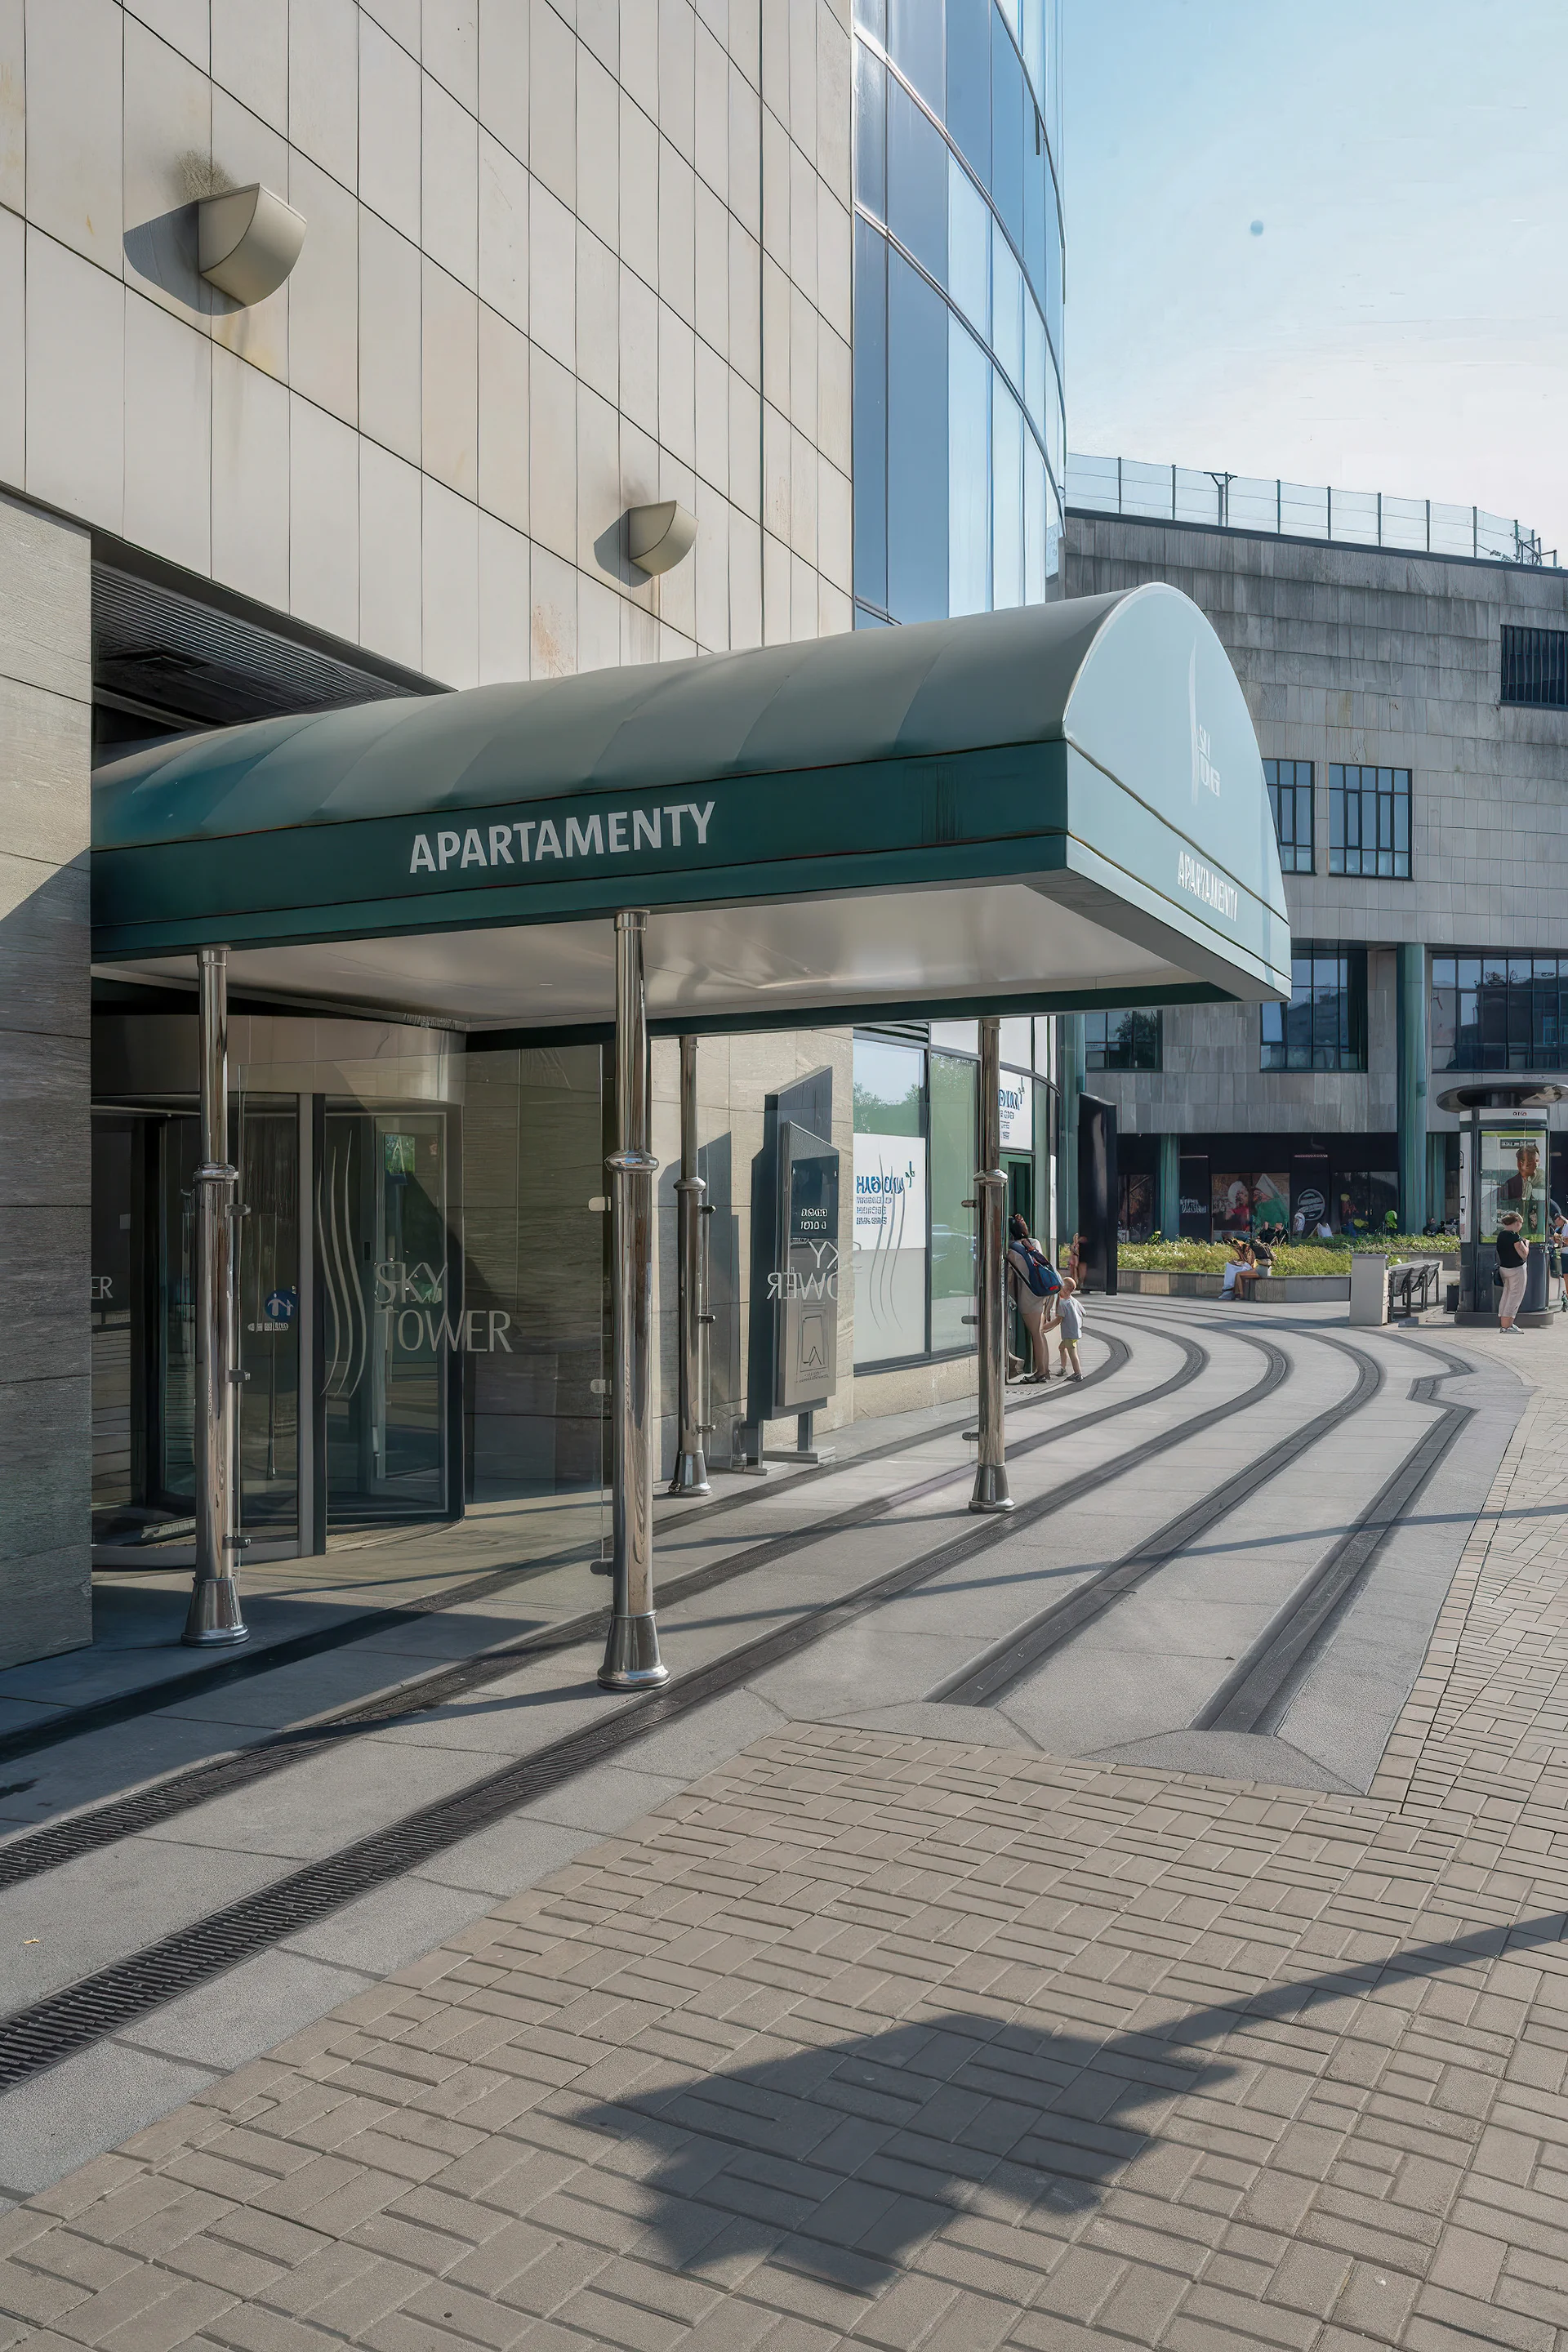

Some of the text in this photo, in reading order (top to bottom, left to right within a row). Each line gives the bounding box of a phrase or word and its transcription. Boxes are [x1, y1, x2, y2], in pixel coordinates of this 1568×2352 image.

[409, 801, 715, 874] APARTAMENTY
[374, 1262, 448, 1304] SKY
[373, 1309, 514, 1353] TOWER
